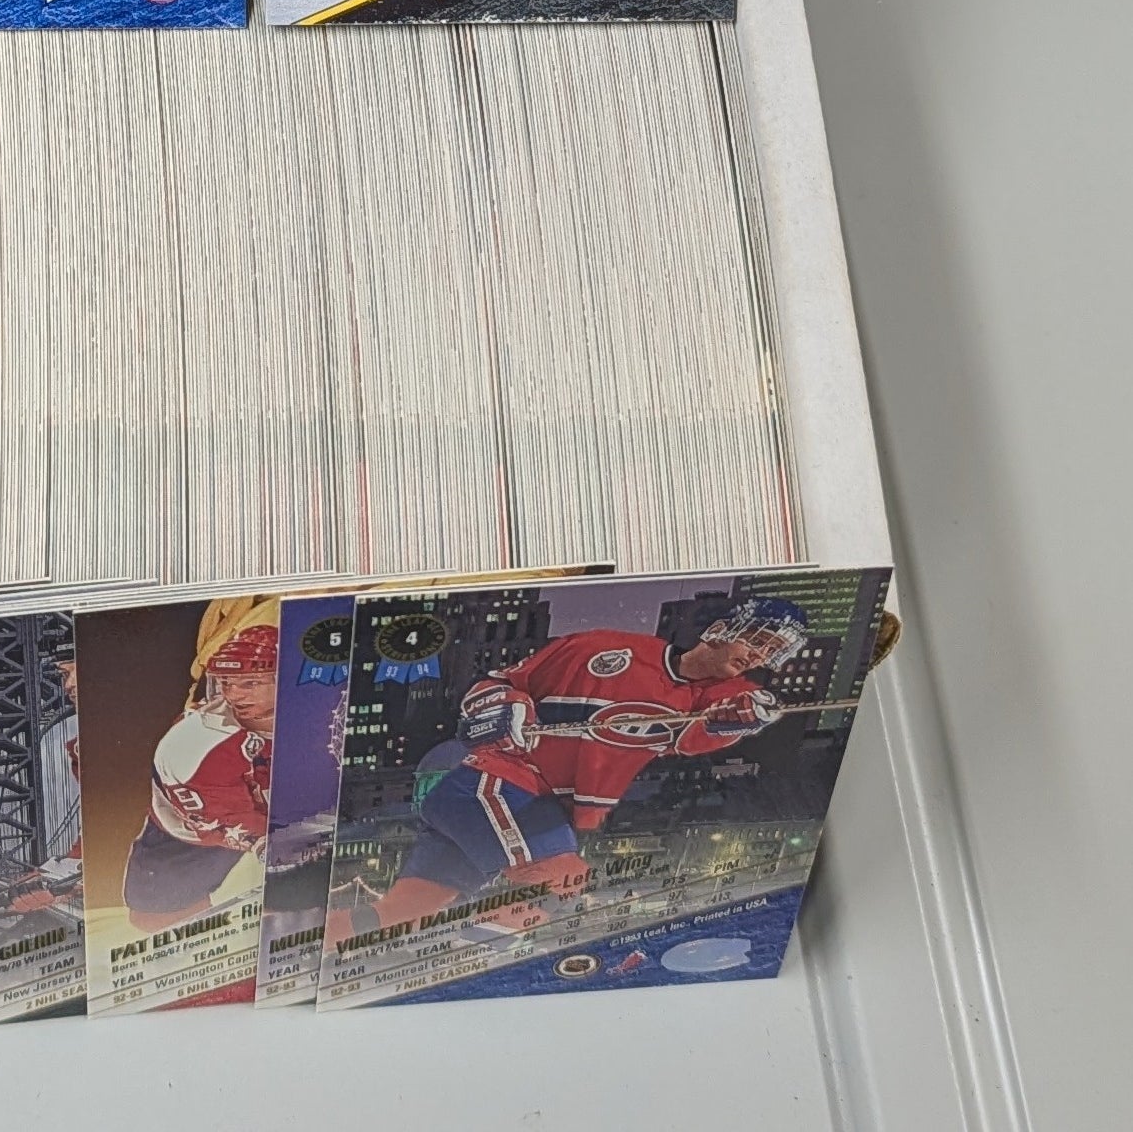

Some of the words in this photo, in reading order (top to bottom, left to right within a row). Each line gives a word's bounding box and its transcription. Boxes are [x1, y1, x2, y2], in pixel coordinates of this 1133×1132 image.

[329, 632, 342, 647] 5
[405, 631, 418, 646] 4
[309, 666, 323, 679] 93
[385, 665, 399, 678] 93
[336, 918, 416, 955] VINCENT
[605, 854, 653, 876] Wing
[693, 907, 731, 925] Printed
[732, 904, 743, 914] in
[745, 897, 767, 910] USA
[333, 965, 365, 982] YEAR
[415, 940, 452, 958] TEAM
[522, 914, 541, 927] GP
[624, 888, 633, 899] A
[661, 874, 688, 887] PTS
[713, 858, 740, 874] PIM
[110, 936, 150, 963] PAT
[183, 936, 210, 953] Foam
[39, 956, 75, 976] TEAM
[112, 971, 144, 988] YEAR
[192, 944, 228, 963] TEAM
[268, 963, 300, 980] YEAR
[403, 976, 427, 990] NHL
[431, 959, 489, 983] SEASONS
[3, 987, 29, 1003] New
[32, 974, 72, 993] Jersey
[113, 987, 143, 1004] 92-93
[154, 958, 224, 990] Washington
[186, 980, 210, 995] NHL
[330, 981, 361, 997] 92-93
[374, 961, 428, 984] Montreal
[25, 1001, 33, 1010] 2
[35, 994, 59, 1008] NHL
